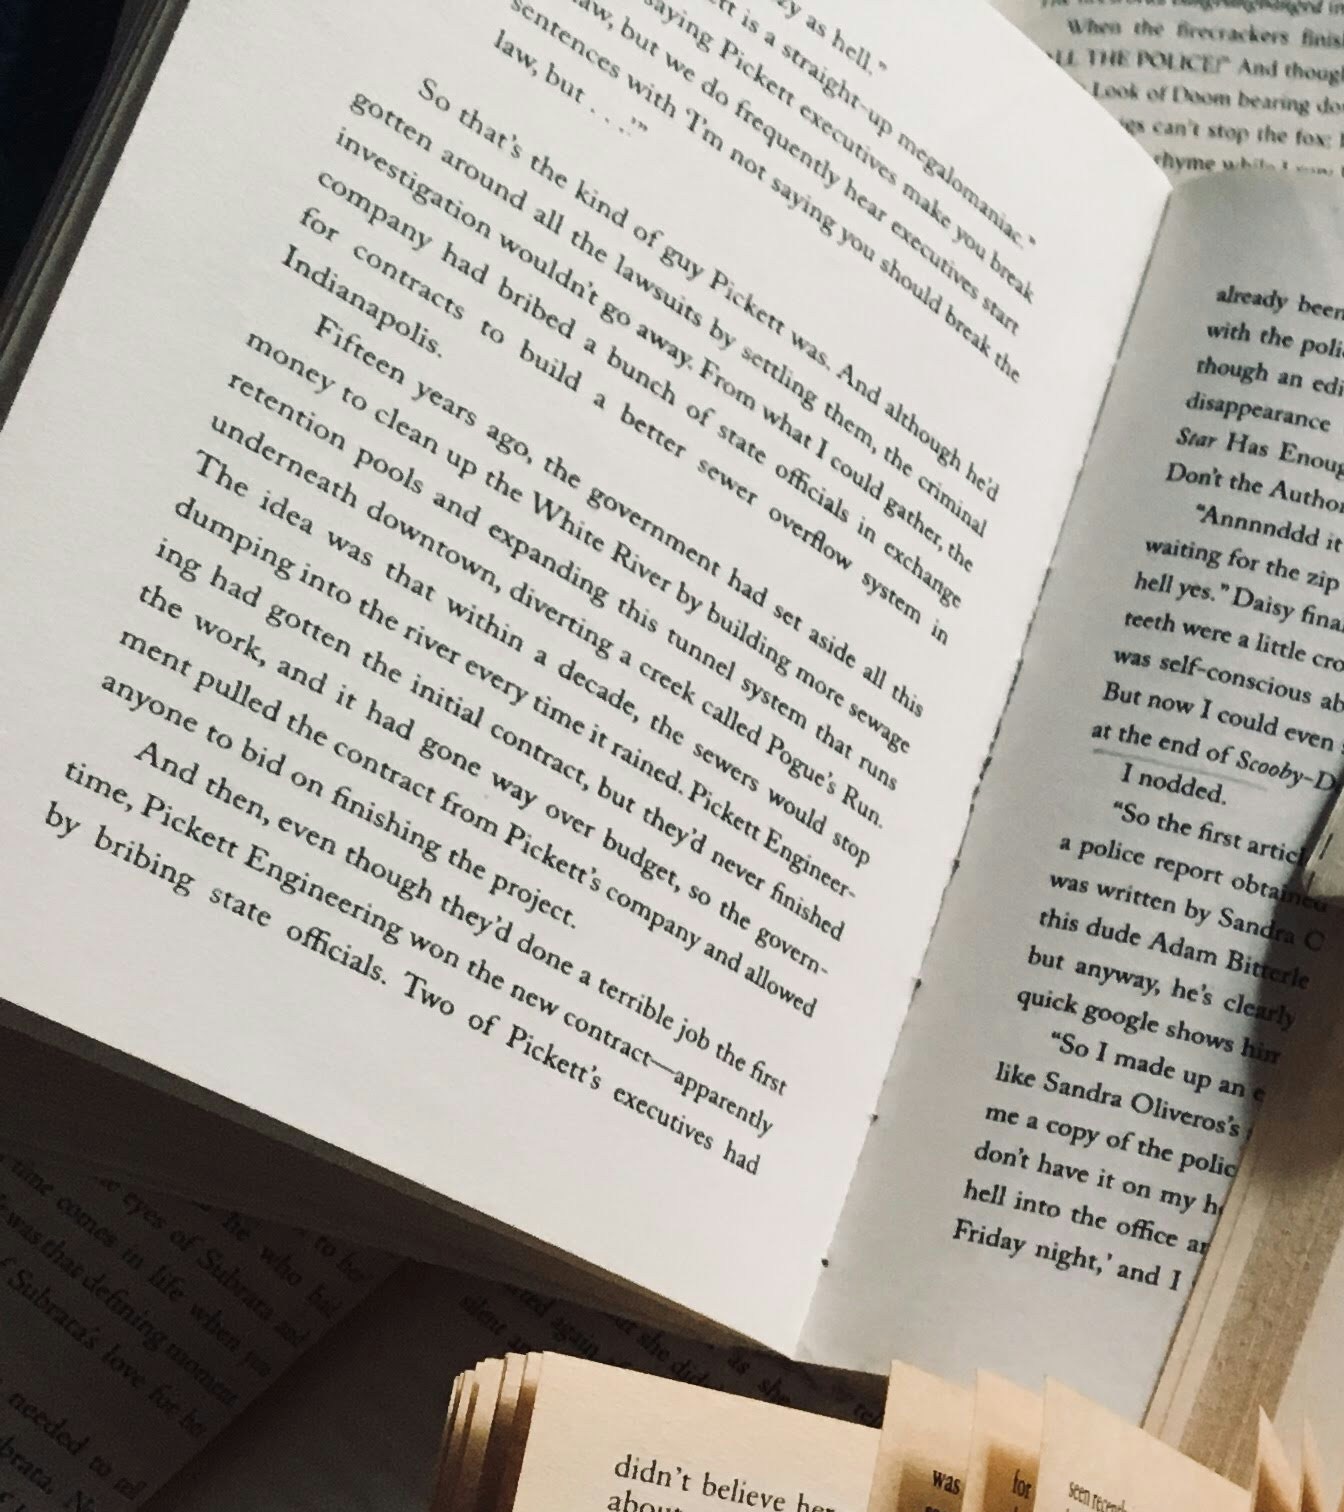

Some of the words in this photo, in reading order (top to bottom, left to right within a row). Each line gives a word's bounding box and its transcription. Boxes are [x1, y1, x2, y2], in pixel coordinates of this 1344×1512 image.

[1175, 426, 1218, 448] Star
[1225, 431, 1269, 457] Has
[1164, 461, 1224, 488] Don’t
[1228, 471, 1263, 495] the
[313, 312, 405, 385] Fifteen
[410, 380, 477, 426] years
[485, 424, 532, 465] ago,
[543, 455, 581, 489] the
[585, 486, 721, 577] government
[726, 566, 768, 608] had
[772, 604, 803, 632] set
[807, 628, 856, 669] aside
[861, 665, 887, 690] all
[891, 684, 923, 718] this
[1120, 761, 1133, 783] I
[1137, 772, 1226, 805] nodded.
[994, 1060, 1036, 1088] like
[1042, 1070, 1122, 1108] Sandra
[1129, 1091, 1241, 1137] Oliveros’s
[613, 1453, 691, 1492] didn’t
[701, 1470, 786, 1512] believe
